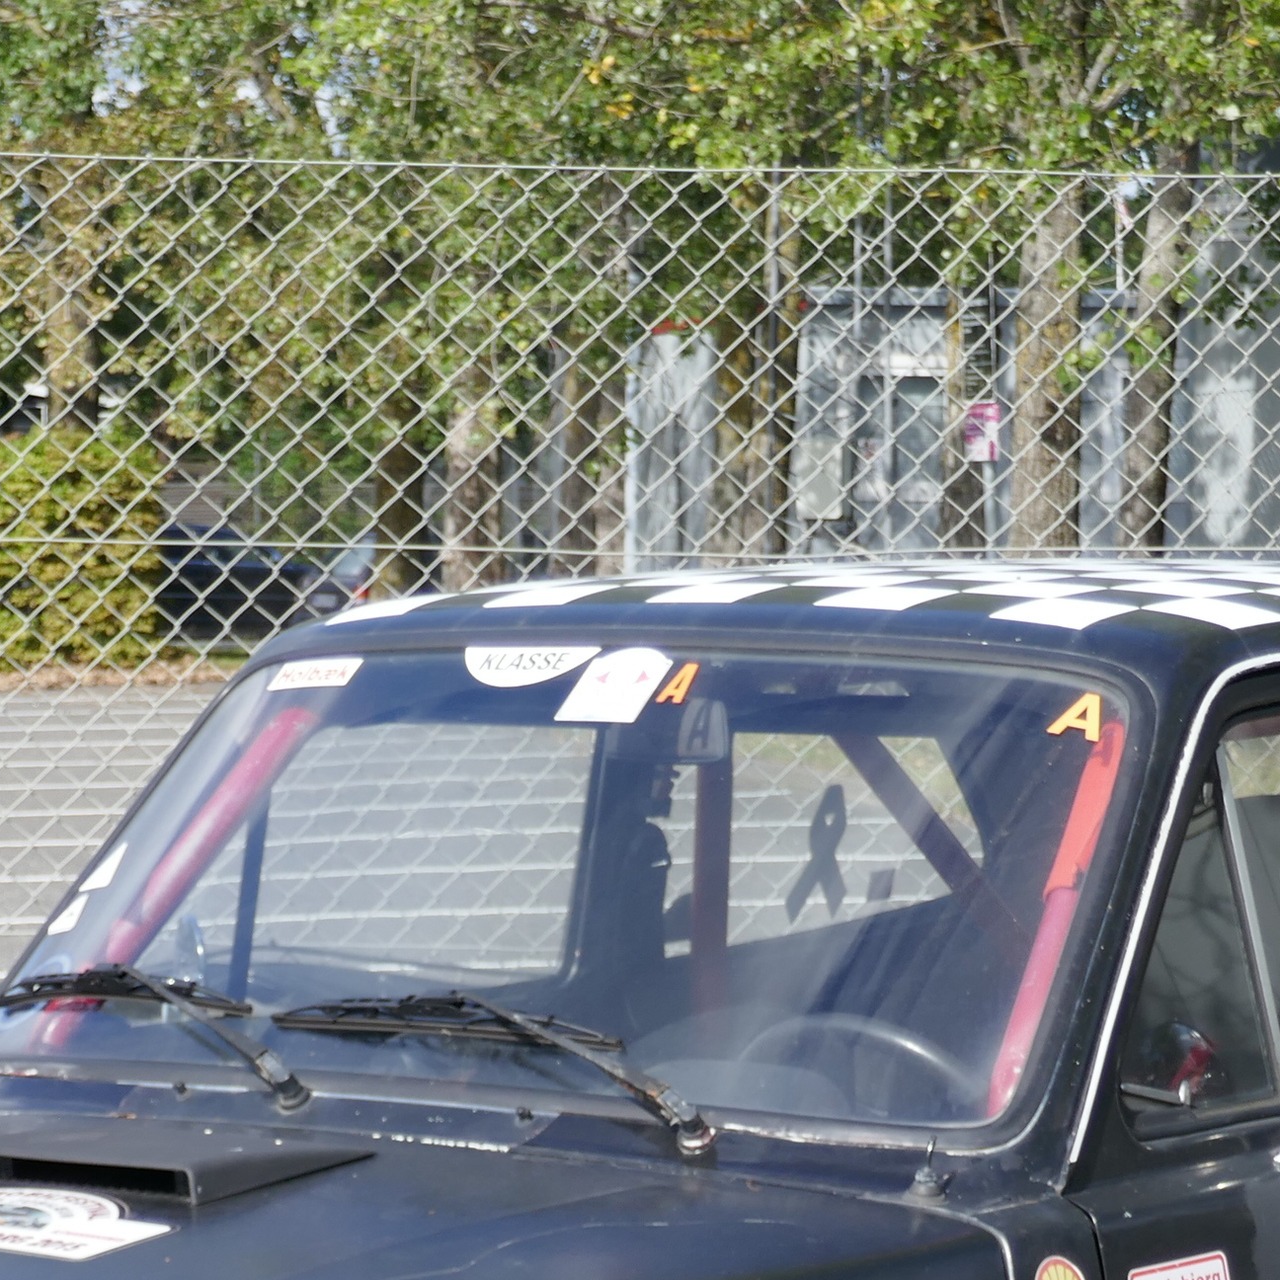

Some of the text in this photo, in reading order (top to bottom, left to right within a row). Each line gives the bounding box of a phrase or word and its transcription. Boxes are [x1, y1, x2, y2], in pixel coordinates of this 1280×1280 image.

[478, 651, 570, 671] KLASSE
[655, 662, 700, 704] A
[1045, 692, 1101, 743] A
